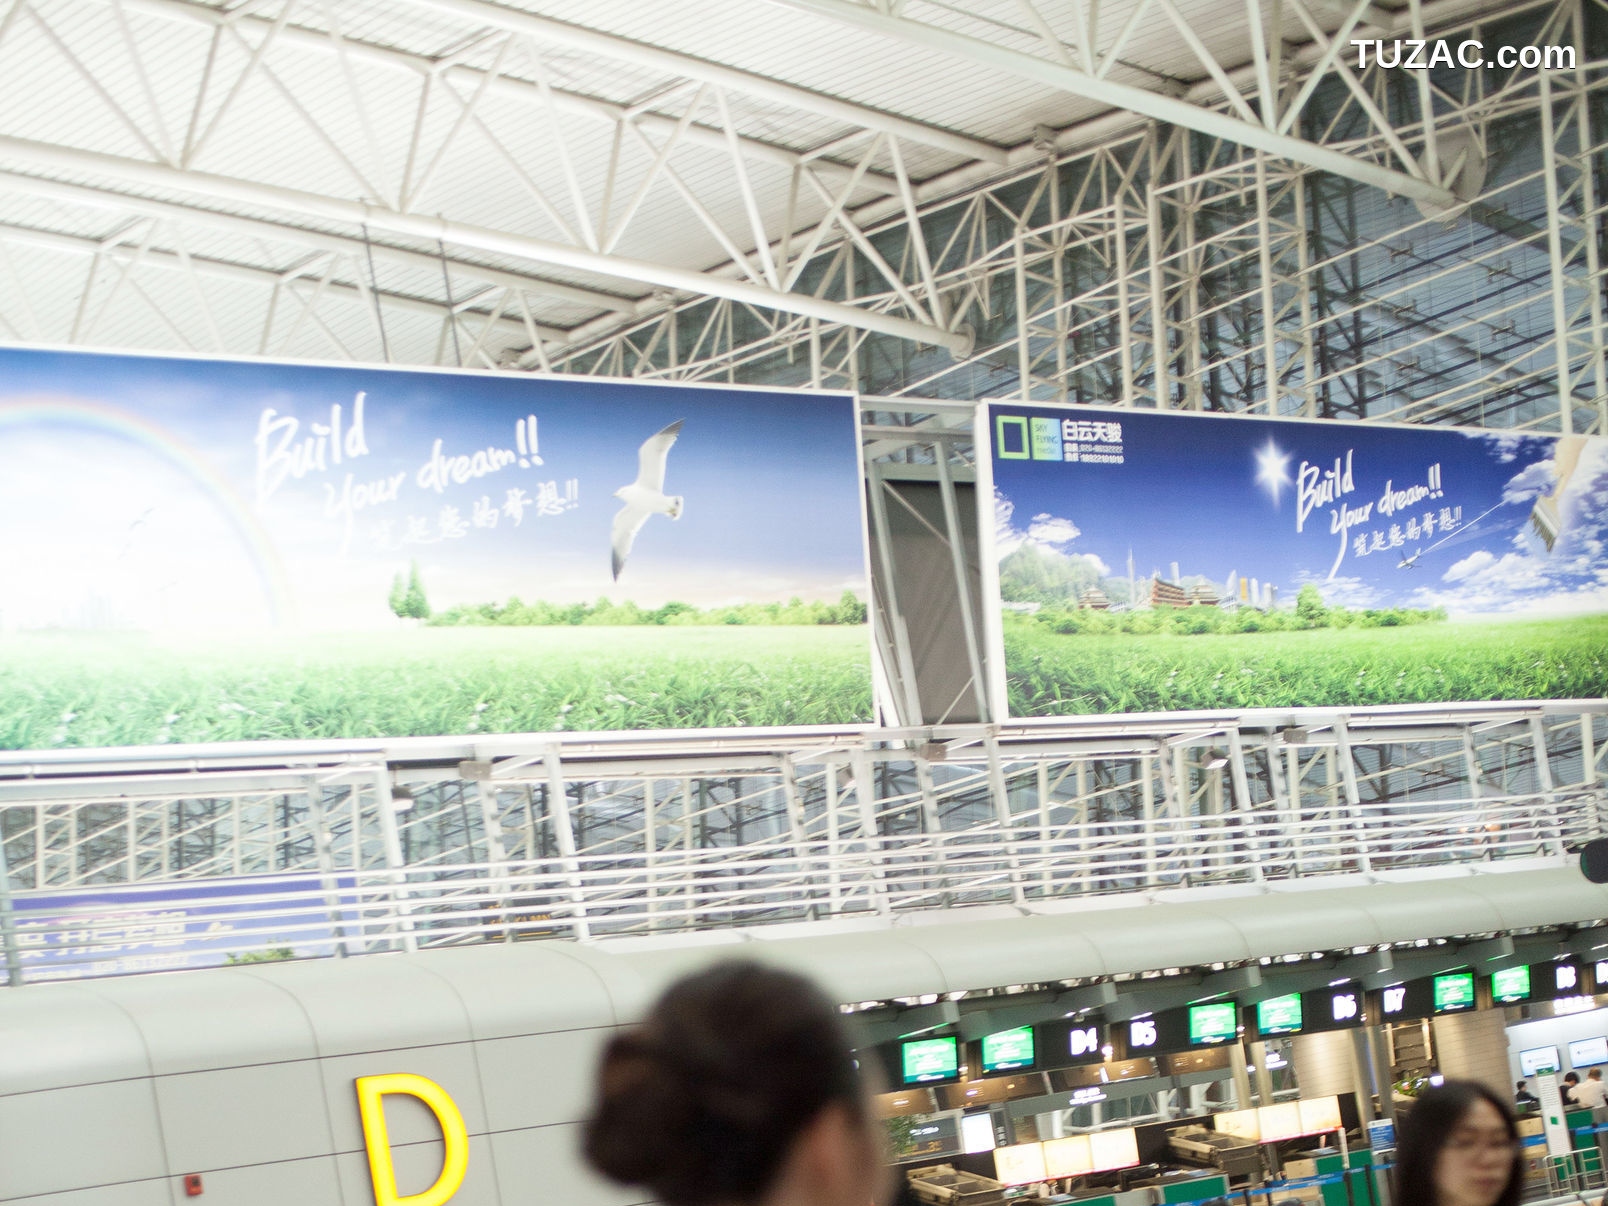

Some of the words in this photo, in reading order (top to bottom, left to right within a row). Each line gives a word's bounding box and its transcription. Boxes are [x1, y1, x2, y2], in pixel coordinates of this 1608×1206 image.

[255, 391, 369, 512] Build
[417, 415, 543, 493] dream!!
[1296, 449, 1355, 533] Build
[1377, 463, 1444, 516] dream!!
[1070, 1027, 1098, 1056] D4
[1130, 1020, 1157, 1047] D5
